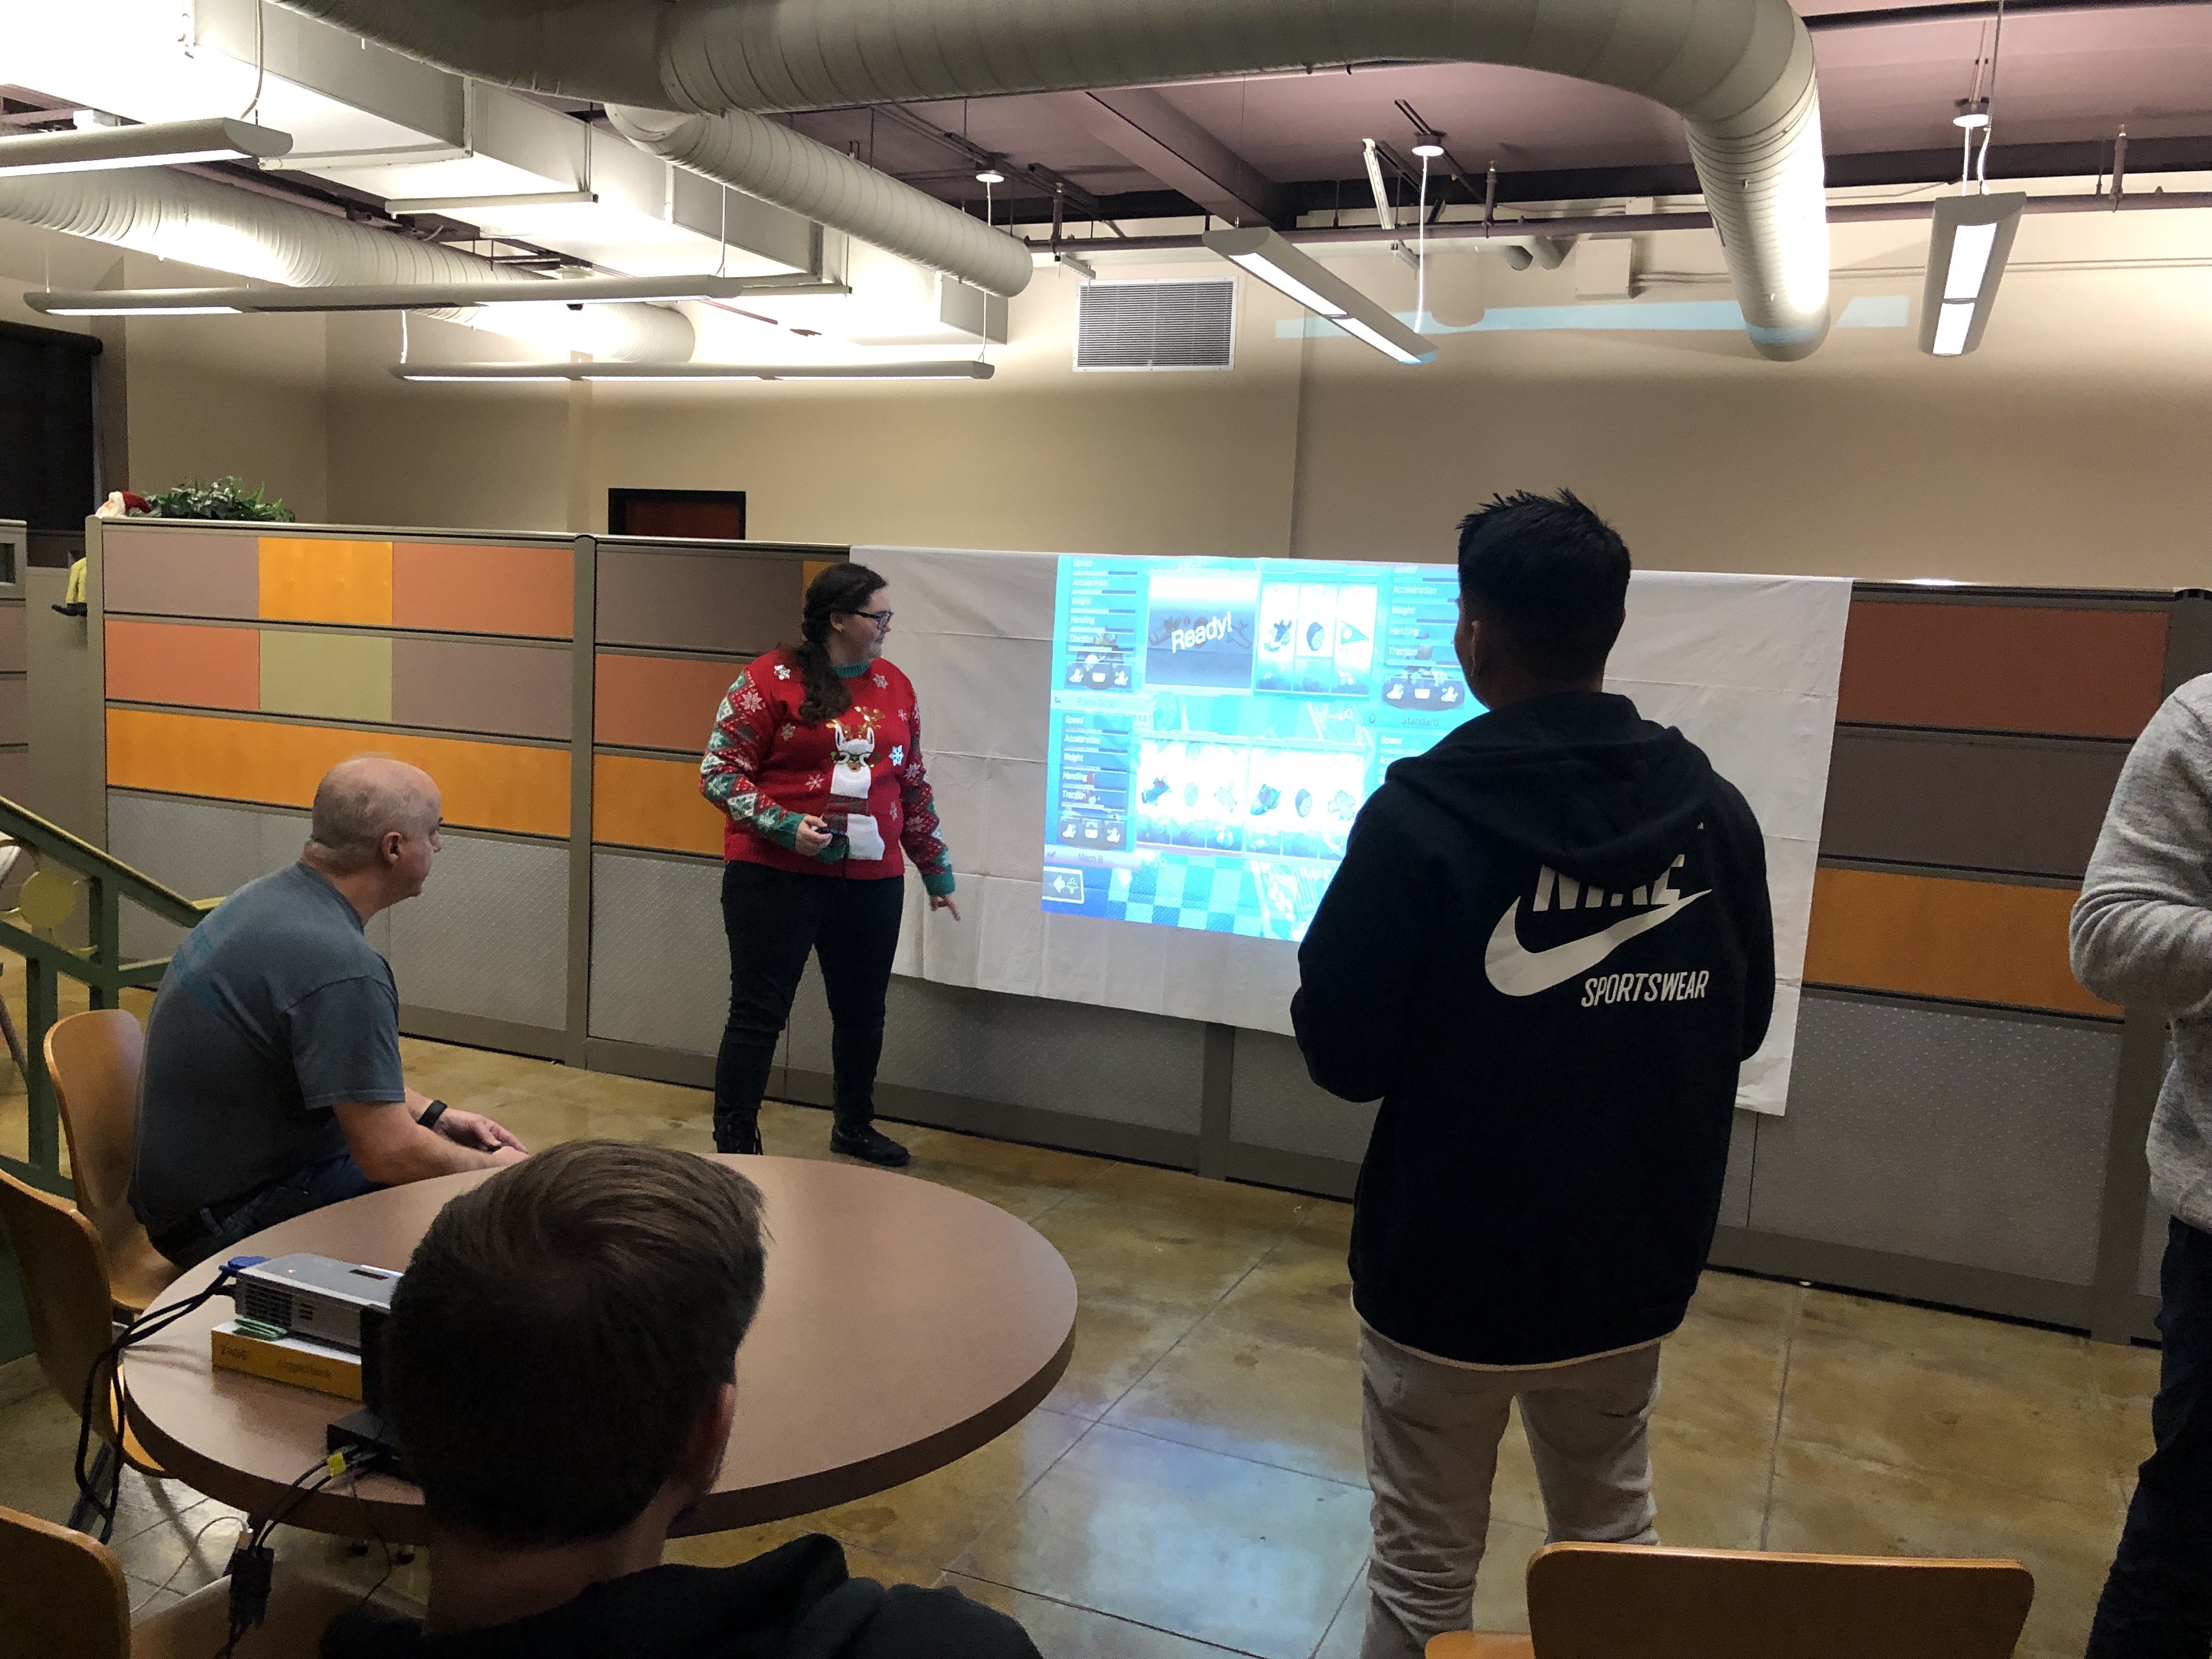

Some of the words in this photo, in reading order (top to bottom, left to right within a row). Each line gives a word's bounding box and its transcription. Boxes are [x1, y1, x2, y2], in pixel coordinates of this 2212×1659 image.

[1392, 585, 1437, 595] Acceleration
[1391, 606, 1415, 616] Weight
[1070, 616, 1096, 625] Handling
[1171, 610, 1233, 653] Ready!
[1389, 628, 1420, 637] Handling
[1388, 646, 1418, 656] Traction
[1065, 715, 1084, 725] Speed
[1401, 715, 1440, 727] Standard
[1064, 735, 1101, 744] Acceleration
[1380, 735, 1403, 745] Speed
[1064, 753, 1084, 762] Weight
[1063, 771, 1087, 782] Handling
[1063, 790, 1086, 799] Traction
[1581, 970, 1709, 1007] SPORTSWEAR
